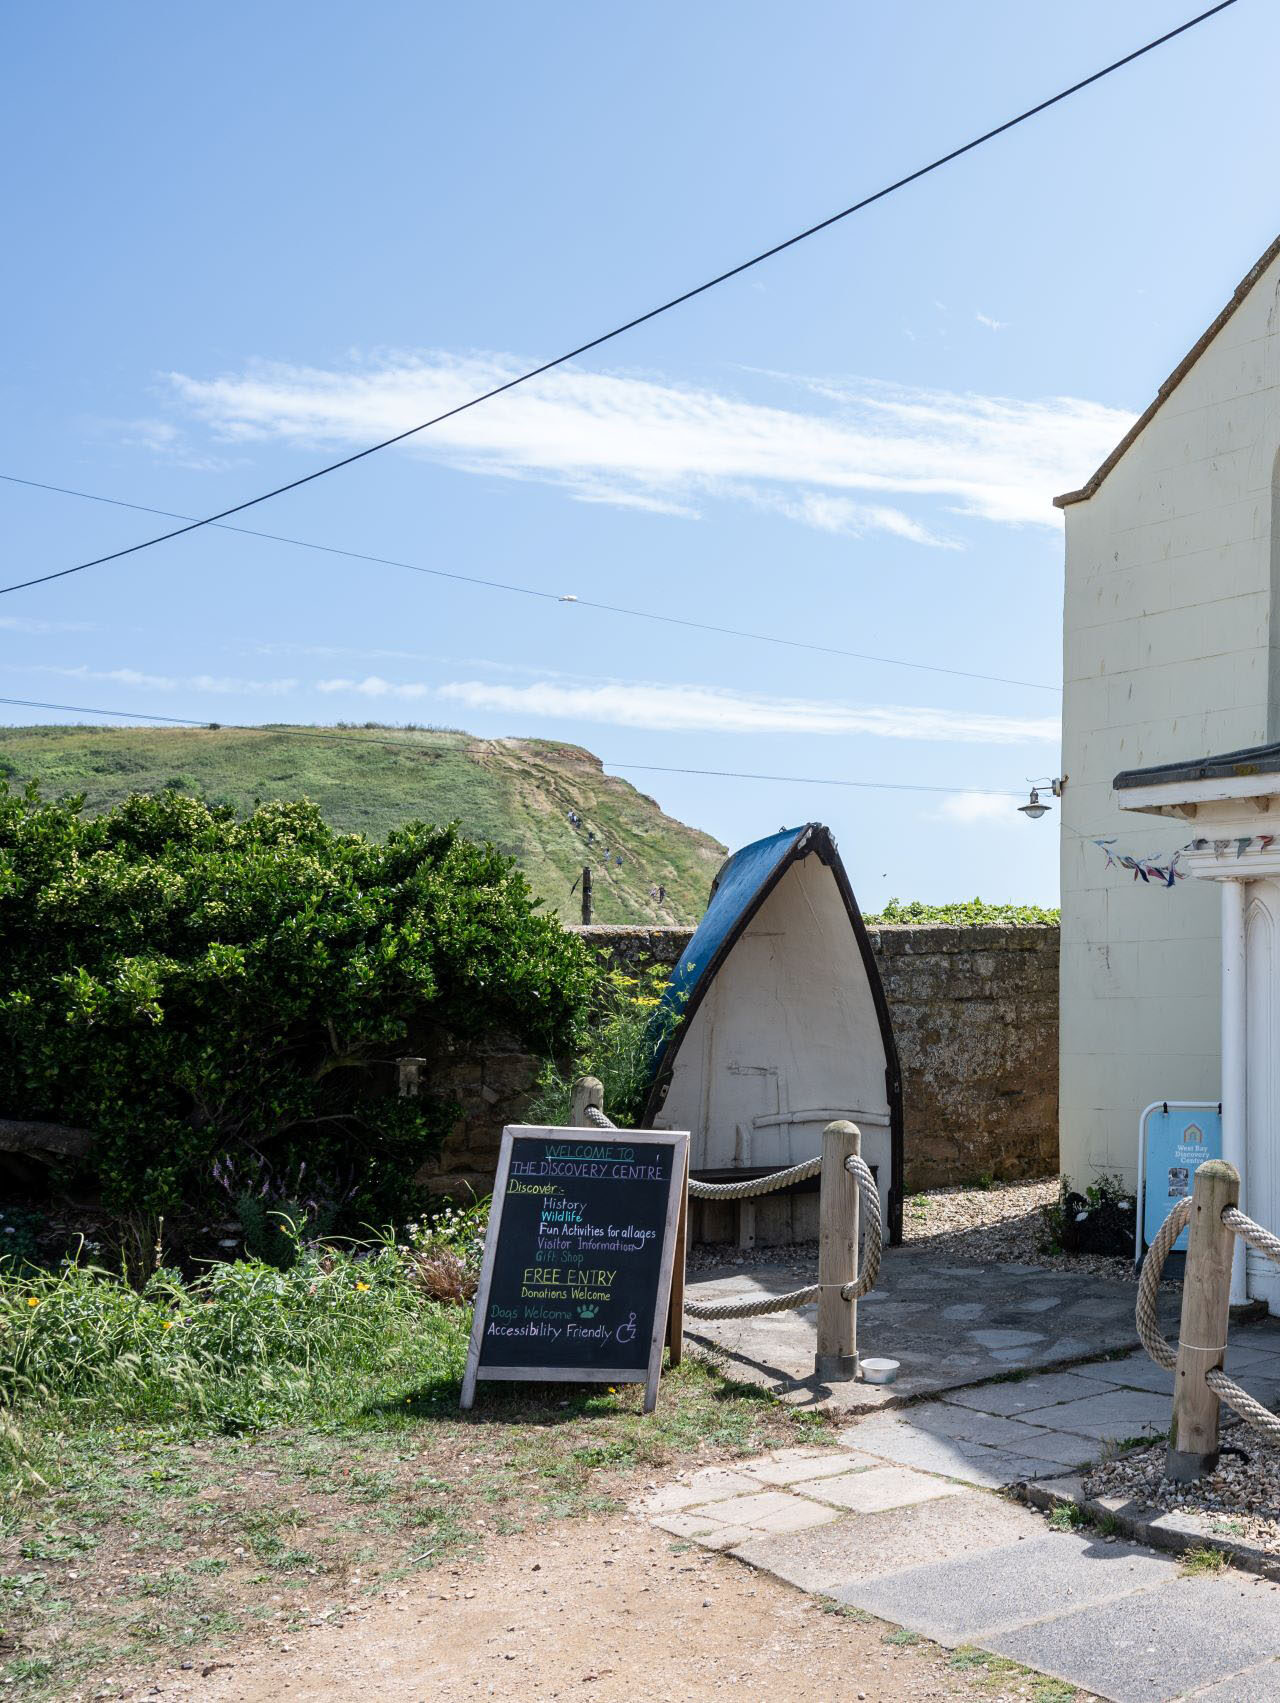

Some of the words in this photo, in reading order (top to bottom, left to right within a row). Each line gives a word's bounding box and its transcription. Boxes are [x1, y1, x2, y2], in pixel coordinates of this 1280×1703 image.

[545, 1145, 614, 1159] WELCOME
[617, 1147, 635, 1160] TO
[1177, 1144, 1193, 1152] West
[1195, 1145, 1208, 1153] Bay
[511, 1161, 537, 1175] THE
[540, 1161, 608, 1177] DISCOVERY
[612, 1164, 663, 1179] CENTRE
[543, 1197, 587, 1215] History
[541, 1211, 583, 1223] Wildlife
[539, 1222, 558, 1235] Fun
[561, 1224, 605, 1236] Activities
[608, 1225, 620, 1238] for
[537, 1236, 572, 1249] Visitor
[577, 1237, 635, 1252] Information
[536, 1250, 556, 1263] Gift
[560, 1252, 584, 1268] Shop
[523, 1268, 561, 1284] FREE
[567, 1269, 617, 1285] ENTRY
[521, 1286, 567, 1299] Donations
[571, 1286, 611, 1301] Welcome
[490, 1304, 518, 1325] Dogs
[524, 1305, 573, 1320] Welcome
[487, 1322, 562, 1343] Accessibility
[566, 1323, 613, 1347] Friendly
